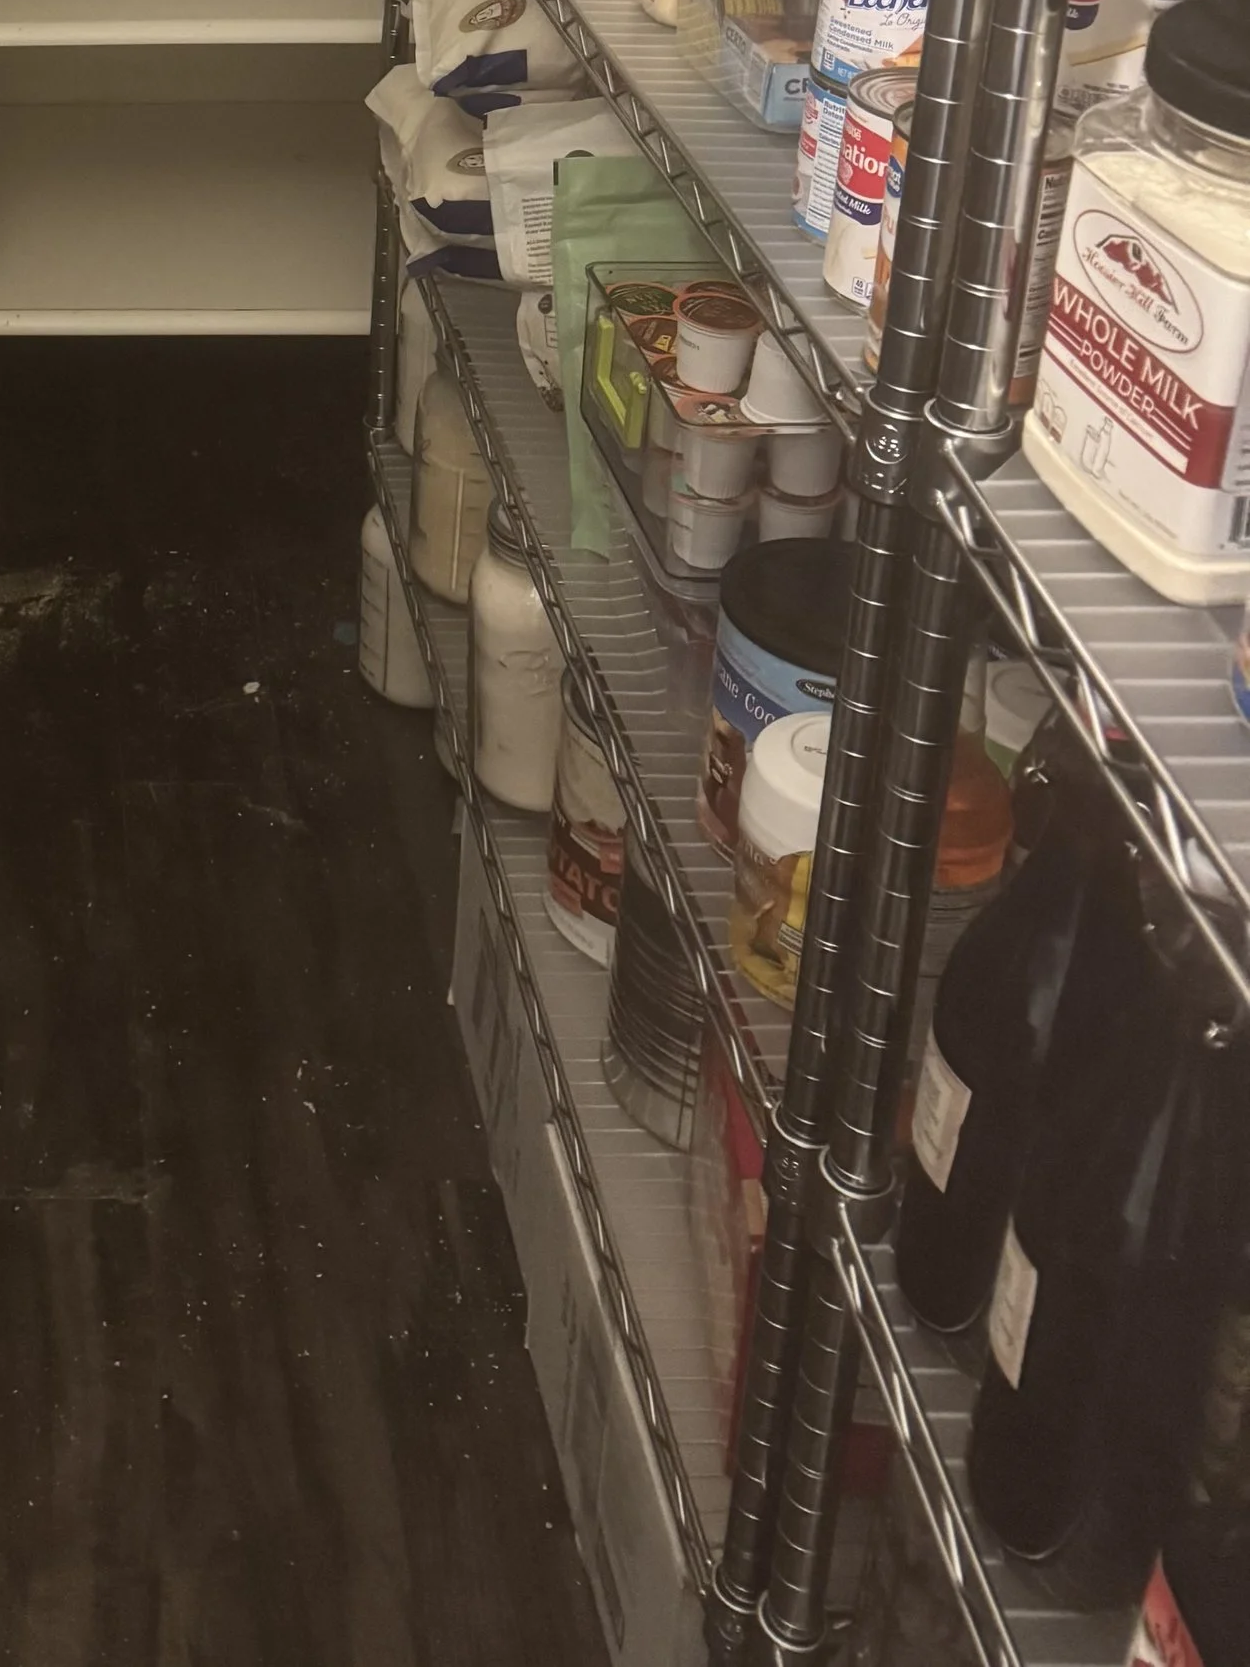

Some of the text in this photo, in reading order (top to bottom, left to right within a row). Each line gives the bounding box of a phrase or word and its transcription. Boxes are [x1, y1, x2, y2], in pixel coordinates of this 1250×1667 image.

[828, 23, 894, 50] Condensed Milk
[830, 15, 873, 36] Sweetened
[848, 196, 872, 216] Milk
[1081, 245, 1190, 347] Hoosier Hill Farm
[1053, 276, 1205, 431] WHOLE MILK
[1079, 337, 1157, 416] POWDER
